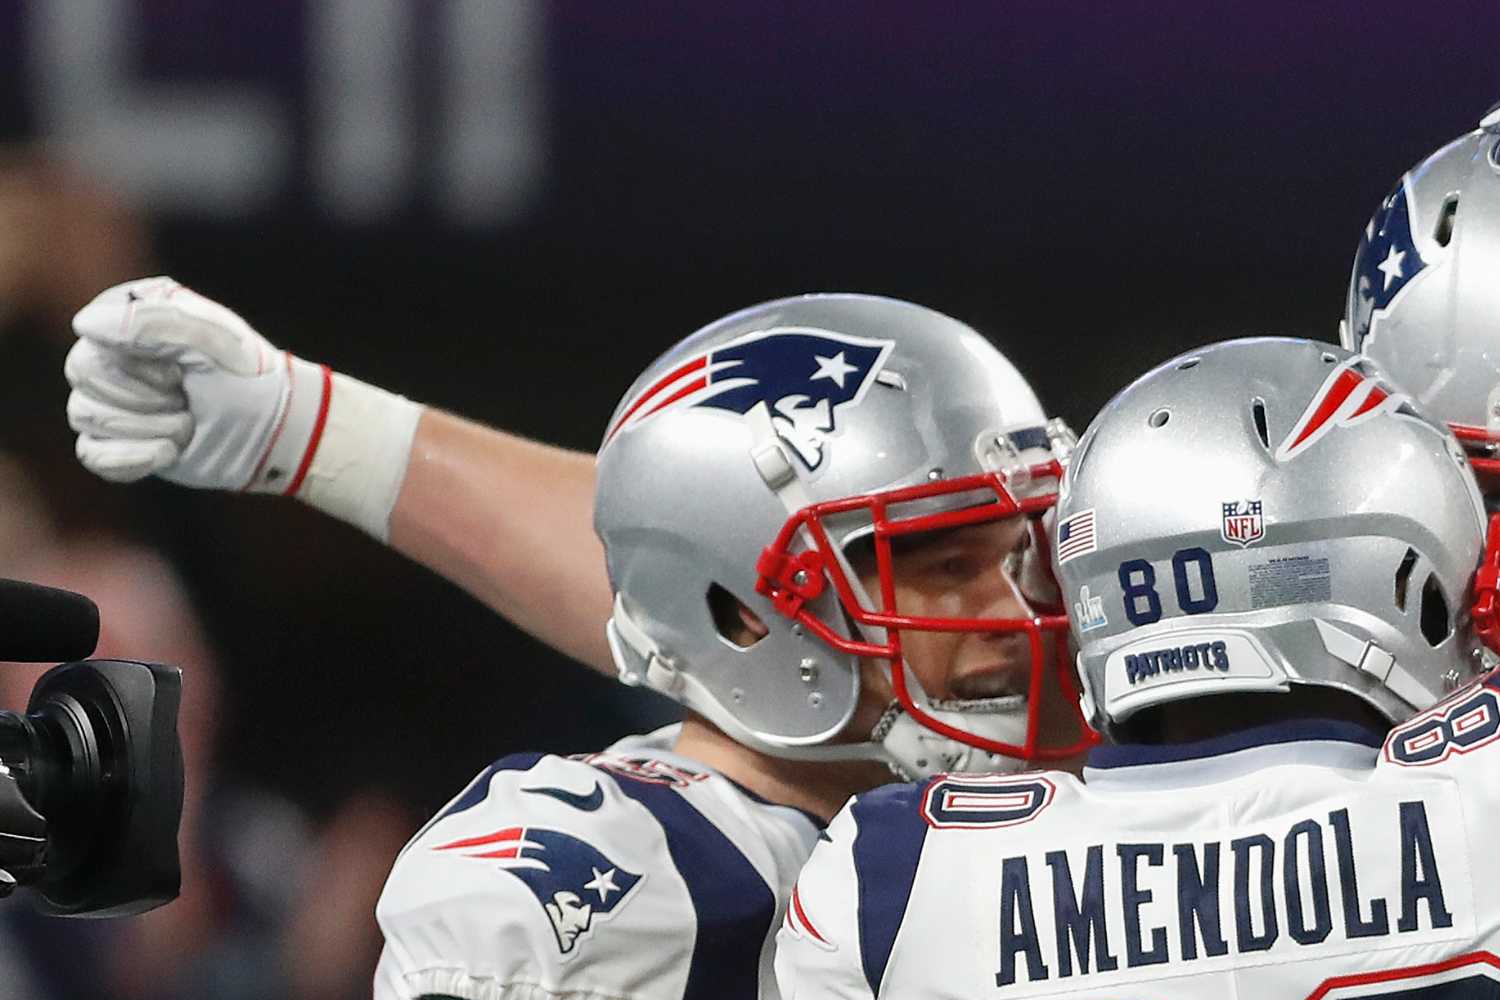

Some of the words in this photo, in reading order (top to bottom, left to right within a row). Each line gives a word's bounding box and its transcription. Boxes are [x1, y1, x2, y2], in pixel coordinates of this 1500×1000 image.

[1226, 517, 1260, 540] NFL
[1118, 547, 1219, 627] 80
[1124, 640, 1230, 685] PATRIOTS
[996, 801, 1453, 987] AMENDOLA
